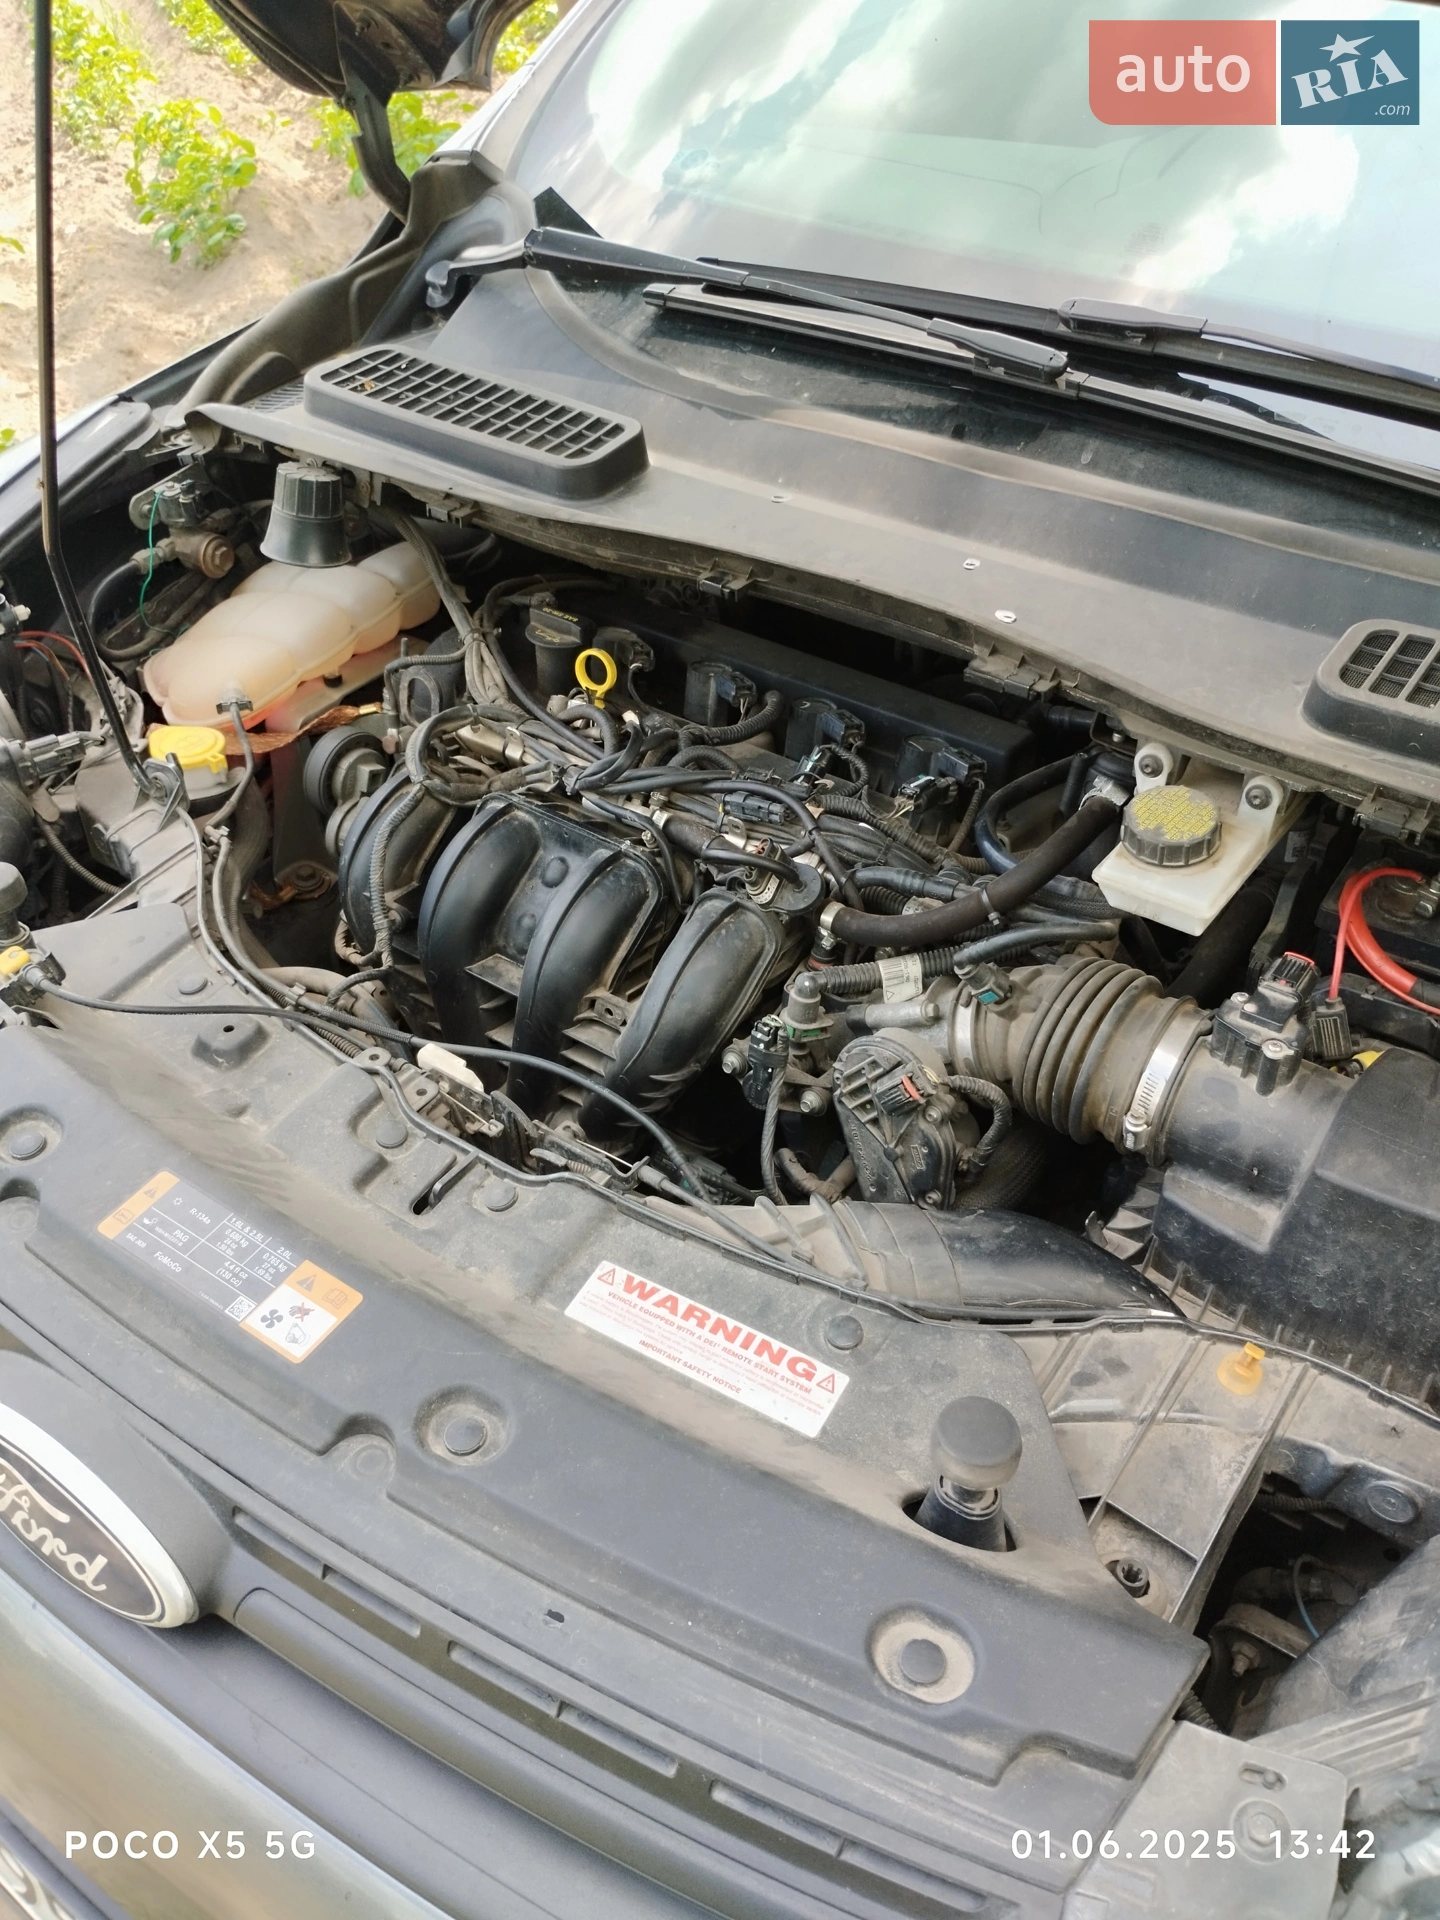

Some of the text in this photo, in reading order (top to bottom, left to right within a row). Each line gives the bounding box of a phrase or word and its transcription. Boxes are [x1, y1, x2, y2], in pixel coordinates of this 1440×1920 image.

[189, 1208, 210, 1224] R-134a
[173, 1230, 189, 1241] PAG
[230, 1218, 243, 1229] 1.6L
[249, 1230, 263, 1242] 2.5L
[240, 1238, 249, 1247] kg
[154, 1252, 181, 1272] FoMoCo
[263, 1253, 287, 1272] 0.765 kg
[277, 1247, 291, 1259] 2.0L
[224, 1262, 235, 1270] 4.4
[216, 1268, 242, 1287] (130 cc)
[624, 1276, 816, 1380] WARNING
[608, 1292, 638, 1309] VEHICLE
[639, 1307, 675, 1326] EQUIPPED
[676, 1324, 695, 1337] WITH
[722, 1347, 752, 1365] REMOTE
[754, 1363, 779, 1377] START
[780, 1375, 811, 1393] SYSTEM
[639, 1340, 741, 1393] IMPORTANT SAFETY NOTICE
